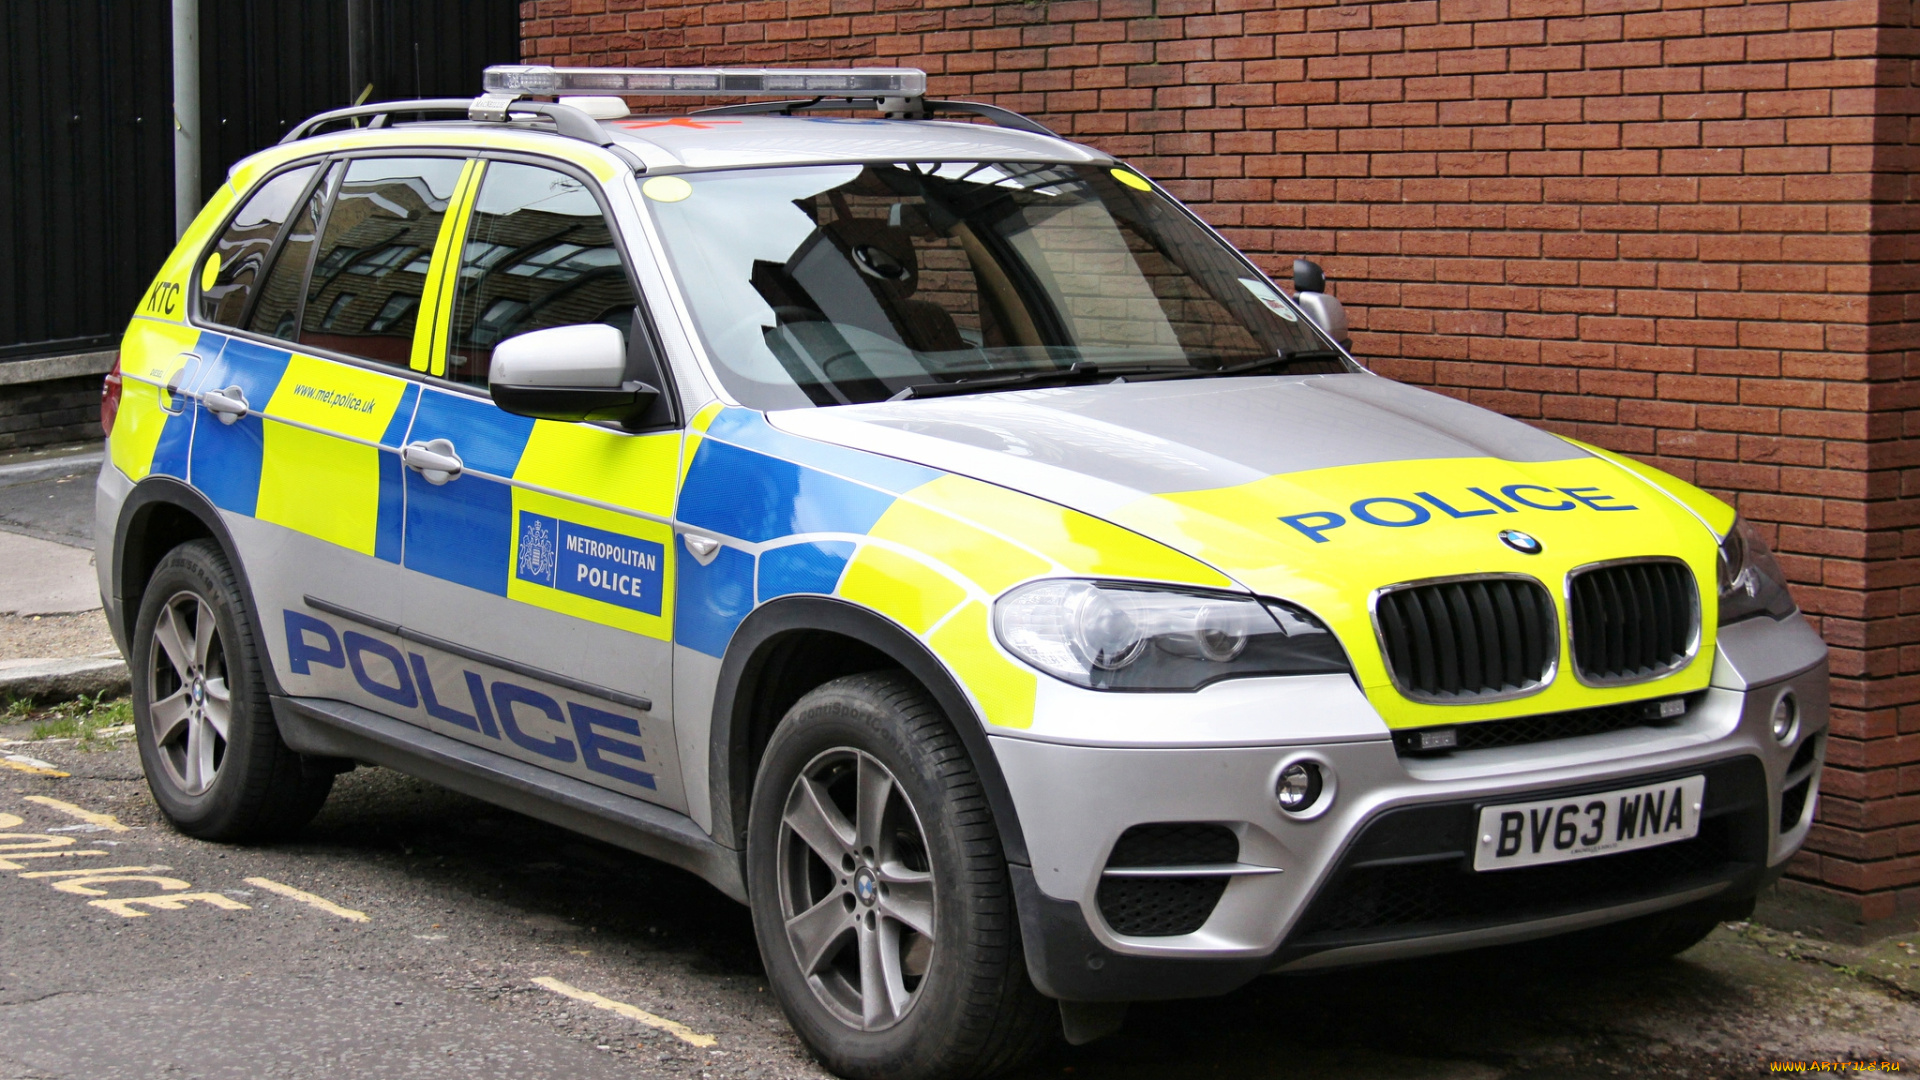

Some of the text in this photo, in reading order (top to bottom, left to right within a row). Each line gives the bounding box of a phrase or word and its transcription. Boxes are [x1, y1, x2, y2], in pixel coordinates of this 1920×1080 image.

[147, 281, 180, 315] KTC
[293, 383, 375, 414] www.met.police.uk
[1277, 484, 1639, 543] POLICE
[566, 534, 656, 571] METROPOLITAN
[577, 563, 642, 598] POLICE
[283, 609, 657, 791] POLICE
[1495, 787, 1682, 858] BV63 WNA
[0, 813, 252, 917] OLICE
